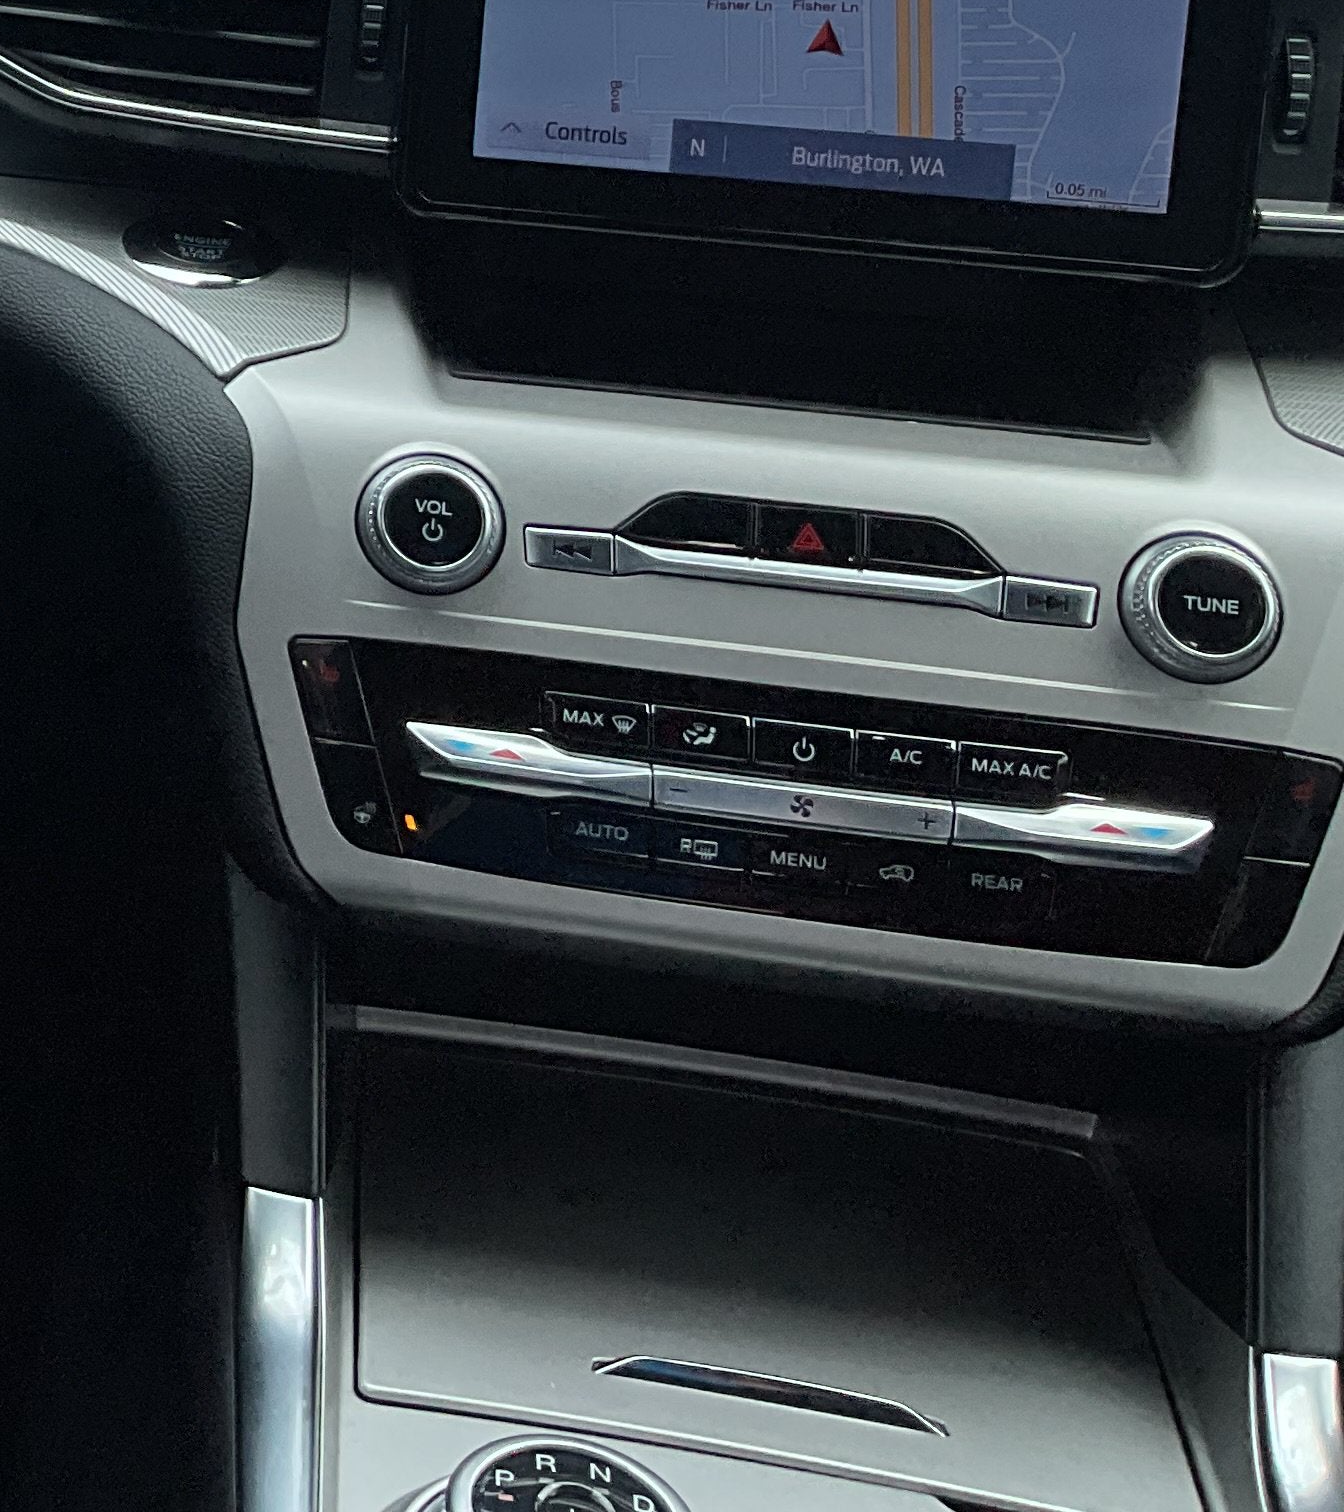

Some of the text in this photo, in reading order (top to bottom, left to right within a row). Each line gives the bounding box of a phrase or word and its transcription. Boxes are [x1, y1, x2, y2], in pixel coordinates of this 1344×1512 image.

[755, 0, 773, 12] Ln
[792, 0, 859, 13] Fisher Ln
[610, 80, 623, 113] Bous
[545, 121, 628, 145] Controls
[689, 138, 706, 157] N
[791, 146, 946, 179] Burlington, WA
[1055, 182, 1107, 198] 0.05 mi
[415, 497, 453, 516] VOL
[1183, 594, 1240, 615] TUNE
[562, 707, 606, 728] MAX
[889, 748, 923, 765] A/C
[971, 757, 1052, 780] MAX A/C
[575, 821, 629, 842] AUTO
[770, 850, 827, 871] MENU
[971, 872, 1024, 893] REAR
[535, 1453, 557, 1473] R
[589, 1462, 611, 1483] N
[494, 1468, 515, 1486] P
[632, 1494, 656, 1512] D
